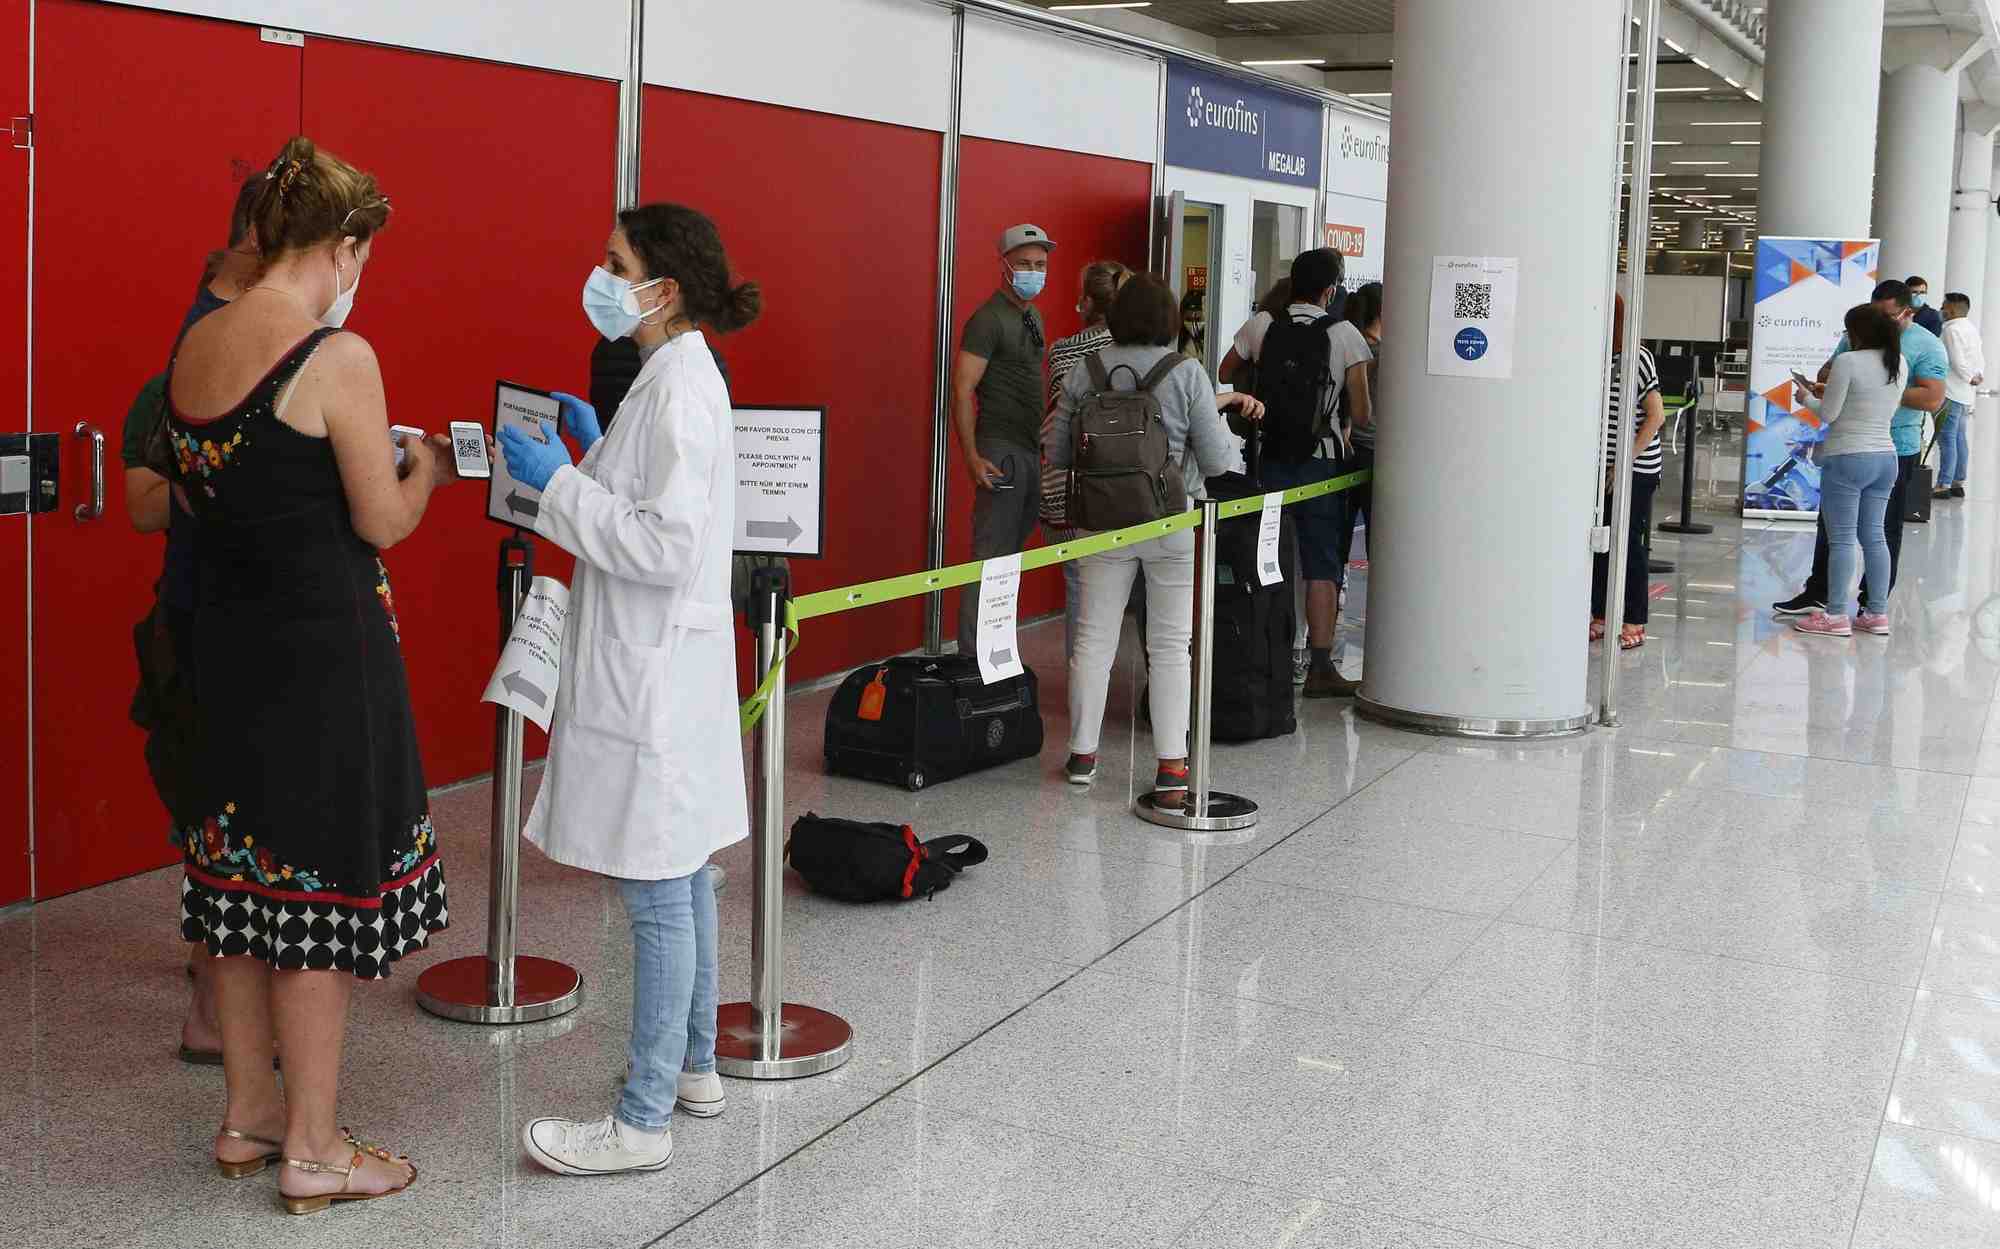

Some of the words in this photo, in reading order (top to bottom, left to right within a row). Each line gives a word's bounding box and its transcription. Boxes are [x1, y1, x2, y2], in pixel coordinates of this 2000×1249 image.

[1205, 100, 1258, 135] eurofins
[1268, 152, 1305, 176] MEGALAB
[1327, 229, 1363, 253] COVID-19
[1774, 317, 1822, 328] eurofins
[762, 488, 786, 496] TERMIN
